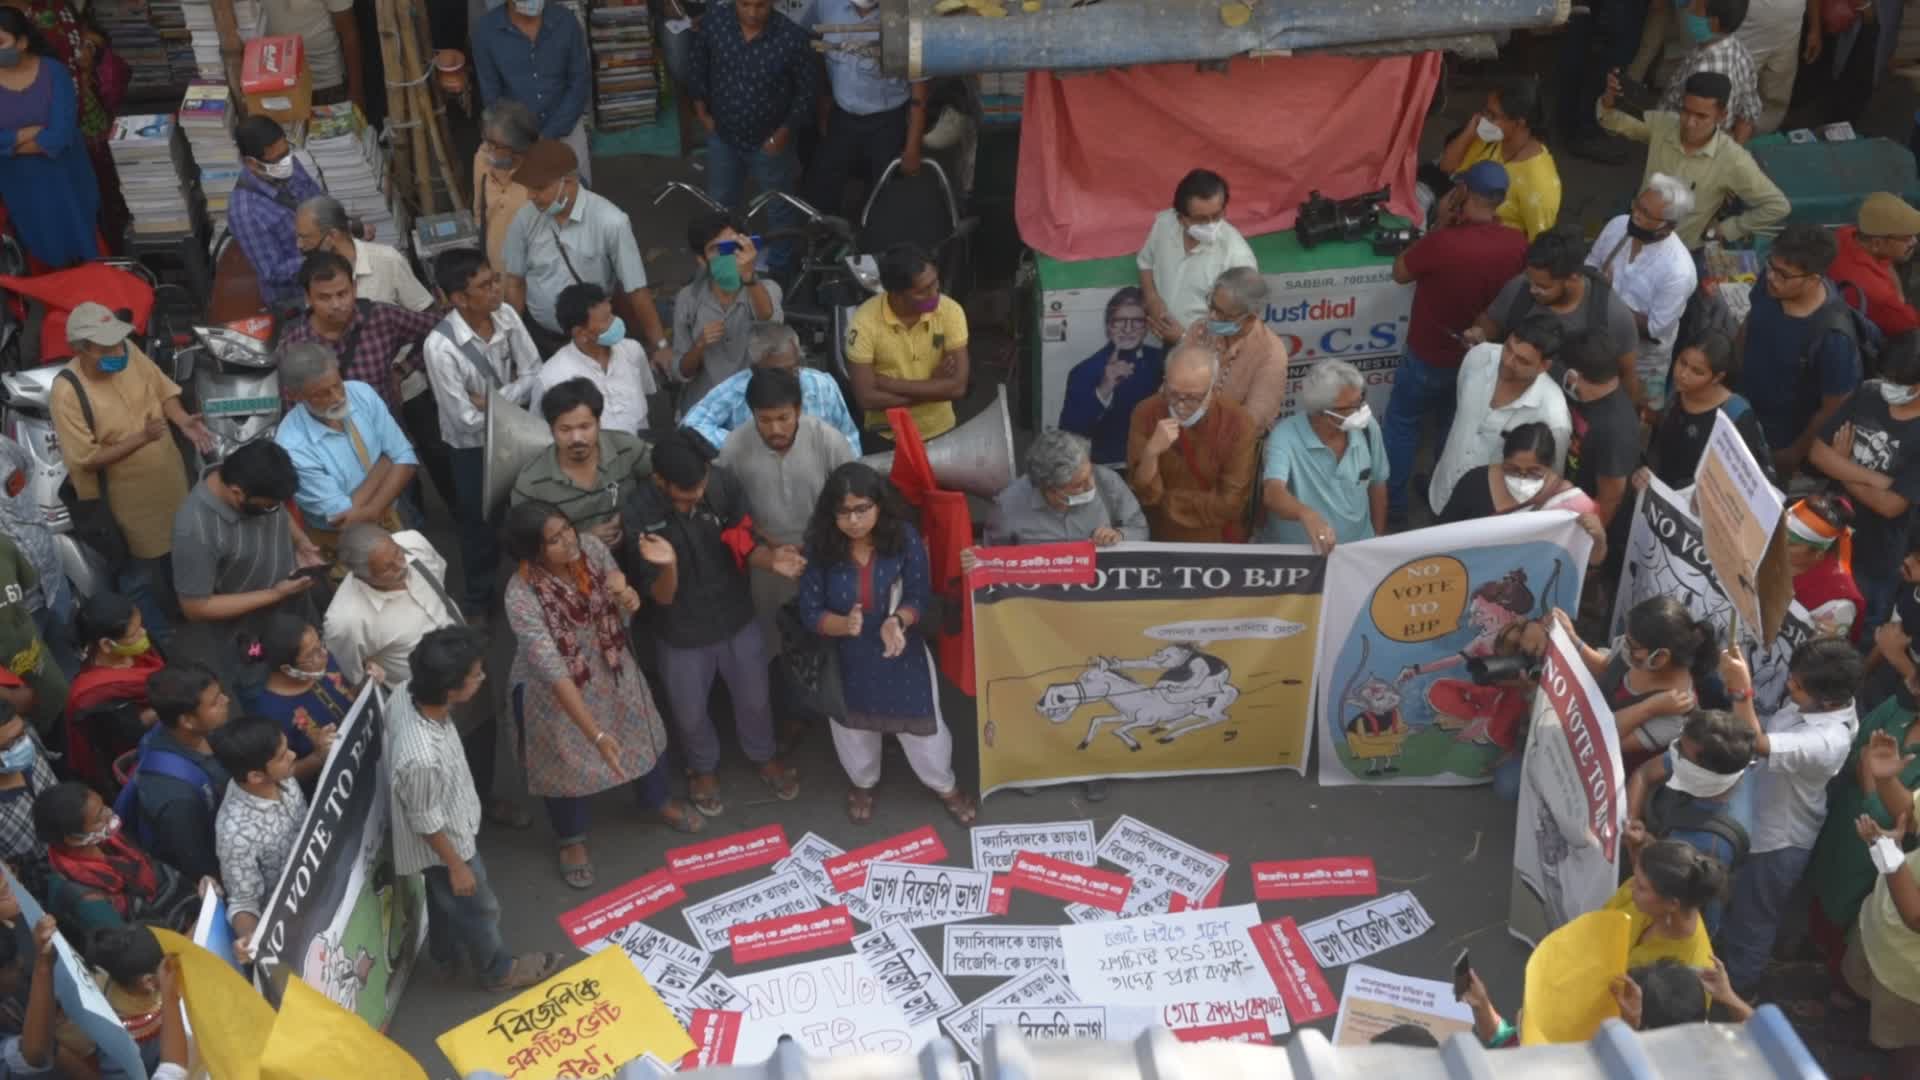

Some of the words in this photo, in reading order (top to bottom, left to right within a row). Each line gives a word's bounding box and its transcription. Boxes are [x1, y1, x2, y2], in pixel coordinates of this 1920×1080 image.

[1649, 502, 1677, 538] NO
[1174, 566, 1231, 589] TO
[1242, 567, 1311, 588] BJP
[1408, 563, 1440, 577] NO
[1392, 578, 1456, 600] VOTE
[1407, 601, 1440, 617] TO
[1542, 657, 1567, 697] NO
[1565, 693, 1595, 767] VOTE
[1588, 760, 1608, 801] TO
[259, 919, 286, 978] NO
[285, 819, 334, 916] VOTE
[325, 767, 354, 821] TO
[748, 971, 817, 1022] NO
[802, 1017, 857, 1050] TO
